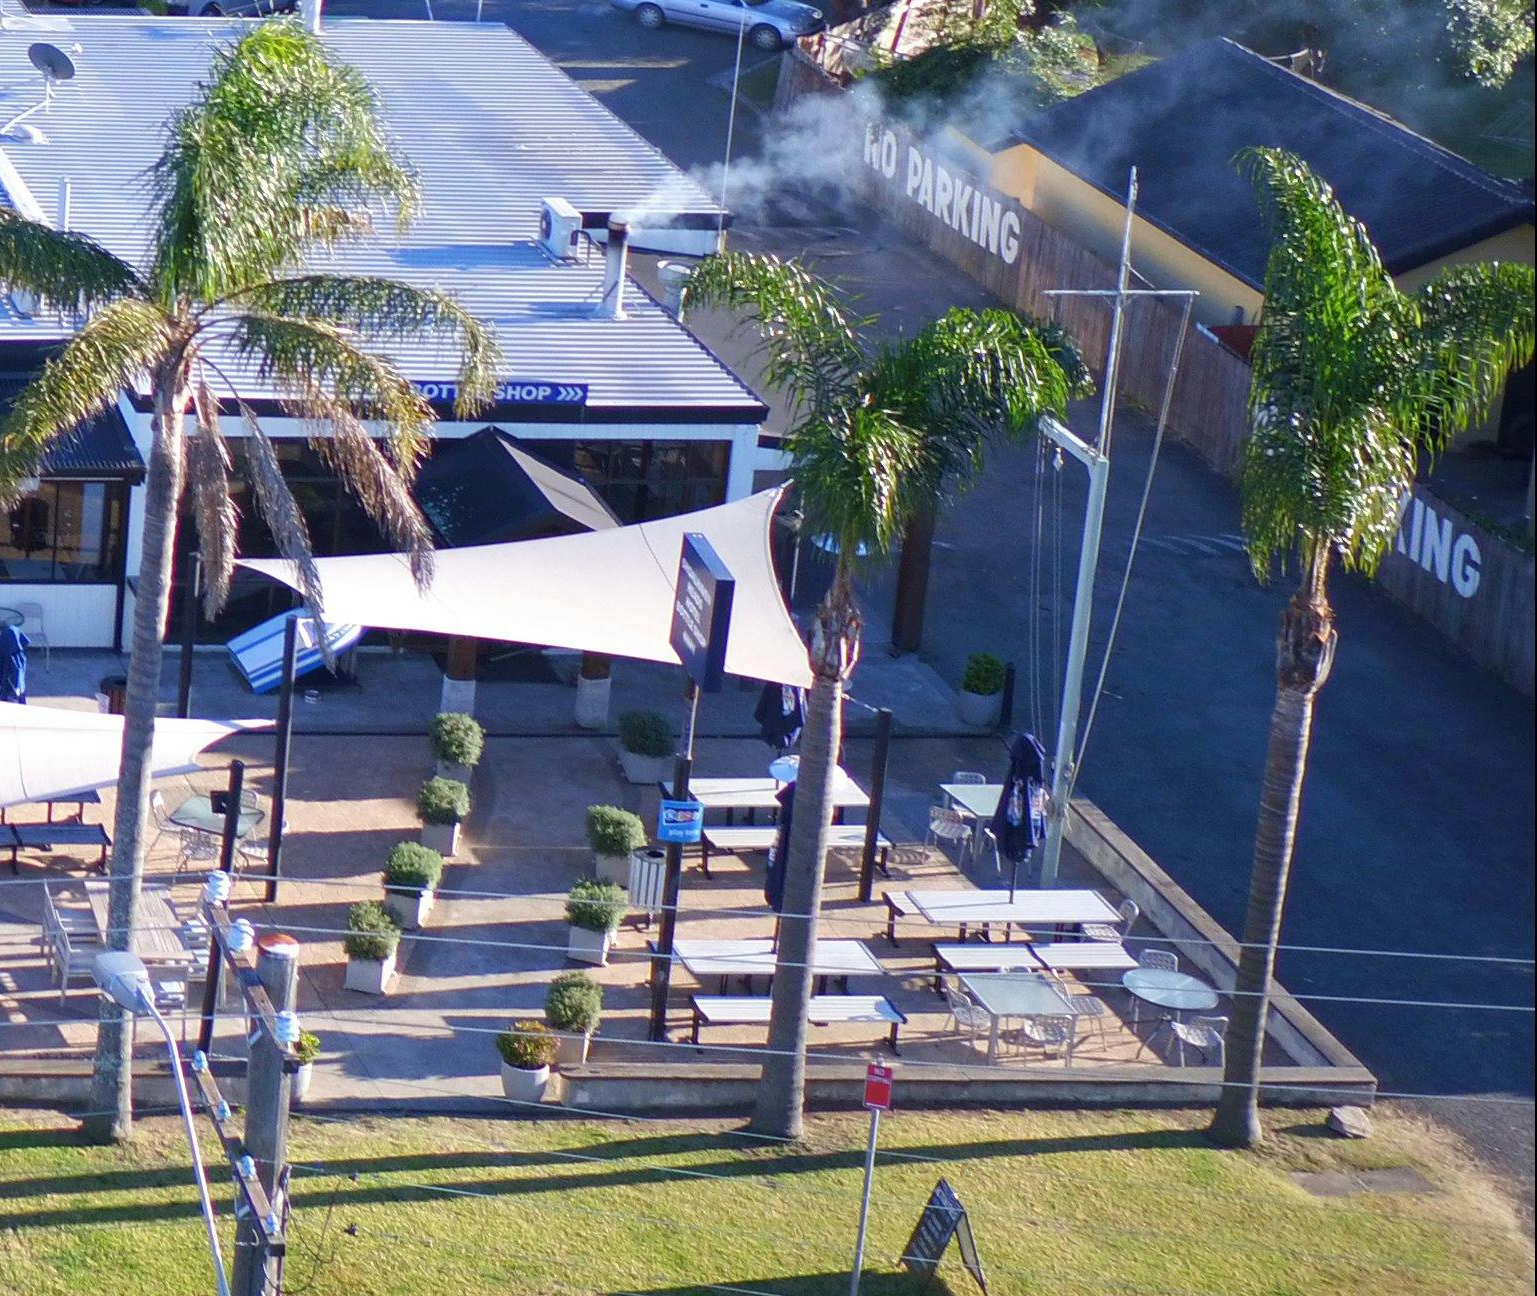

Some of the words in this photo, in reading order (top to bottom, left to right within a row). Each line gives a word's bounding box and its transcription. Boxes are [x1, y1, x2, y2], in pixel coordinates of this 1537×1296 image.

[864, 122, 897, 179] NO
[906, 145, 1022, 265] PARKING
[493, 385, 552, 401] SHOP
